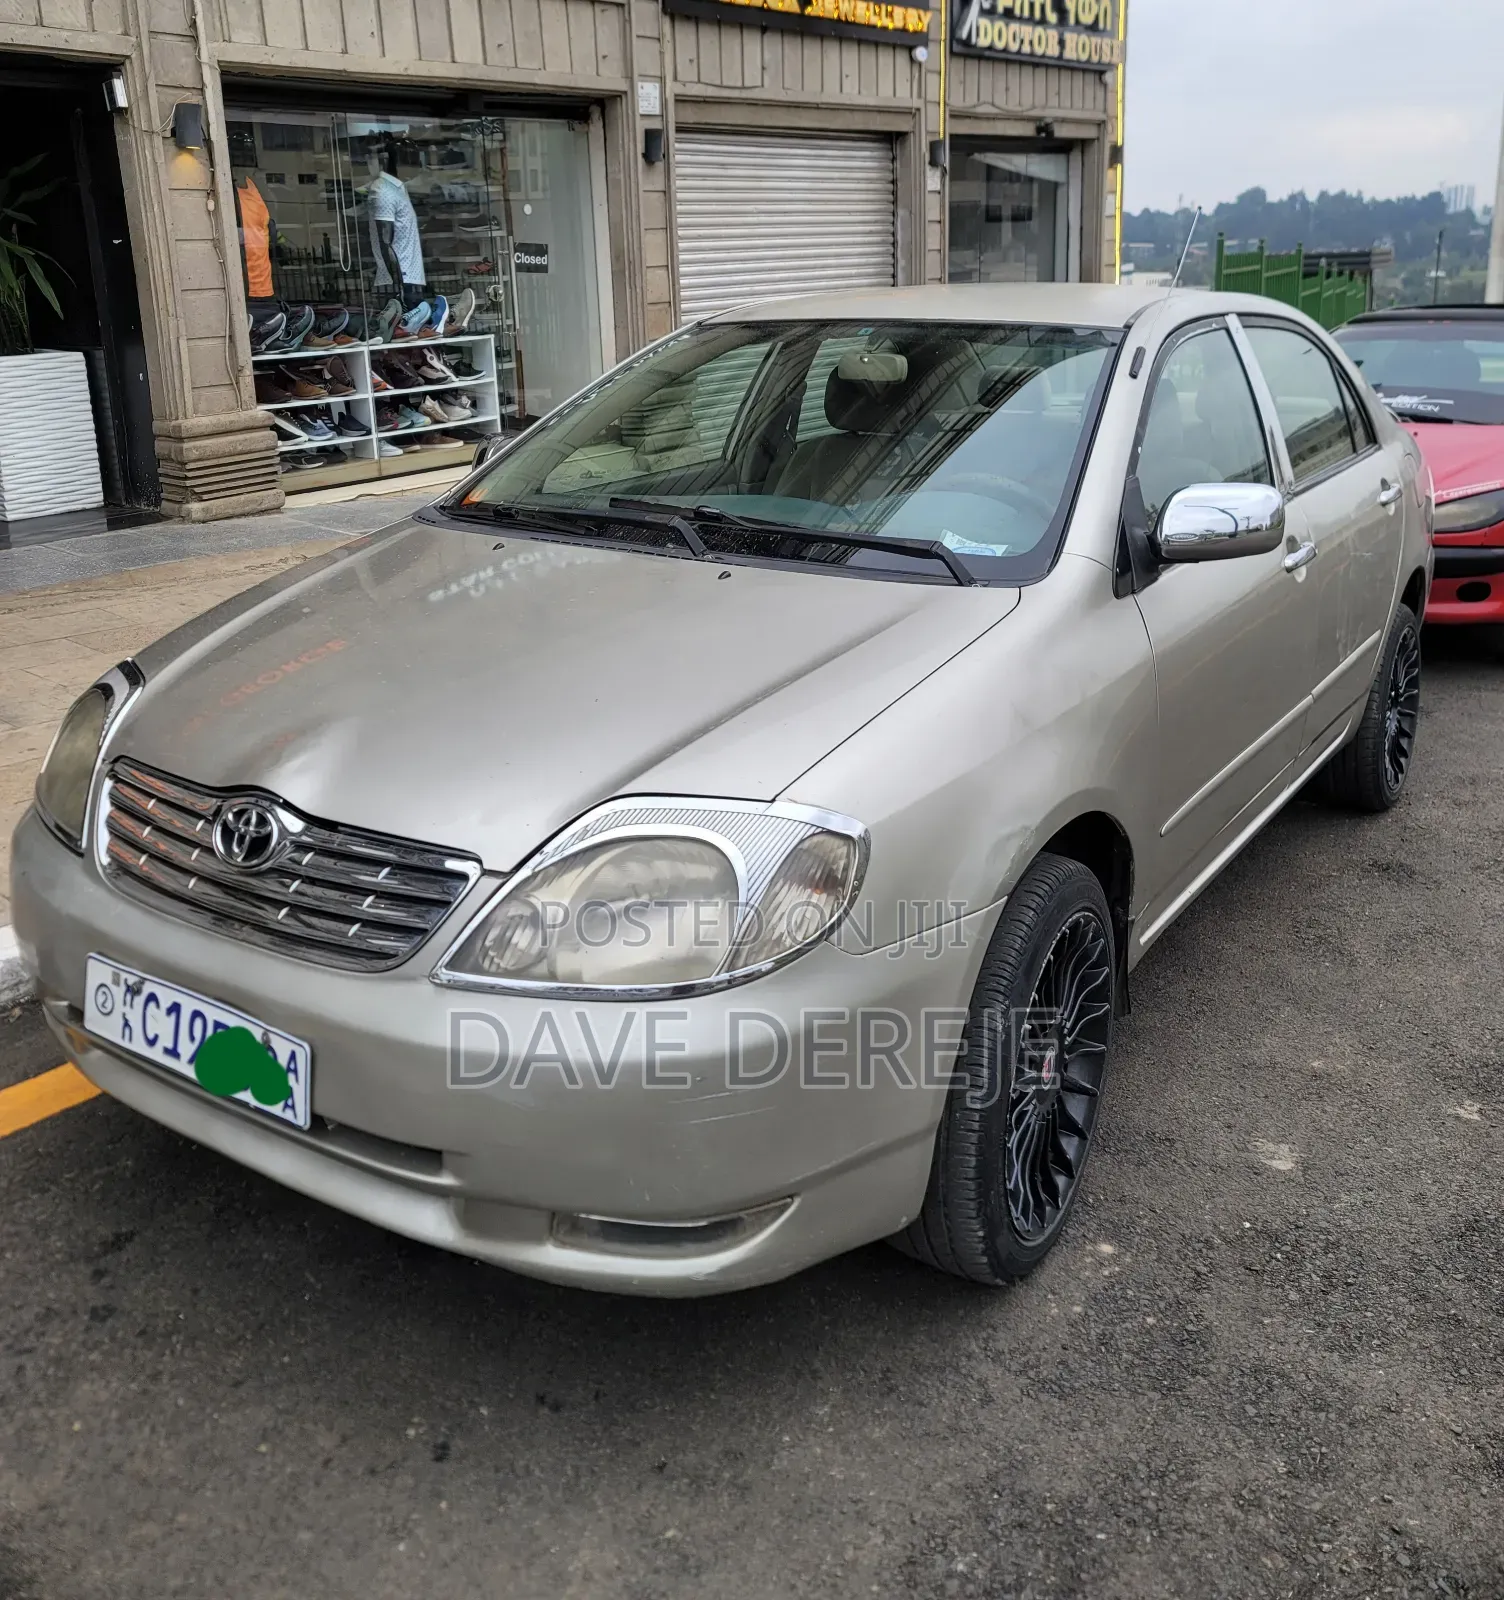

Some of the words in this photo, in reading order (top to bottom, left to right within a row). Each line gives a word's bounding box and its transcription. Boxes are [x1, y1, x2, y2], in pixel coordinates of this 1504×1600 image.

[977, 17, 1060, 58] DOCTOR
[1062, 31, 1123, 64] HOUSE
[514, 252, 548, 265] Closed
